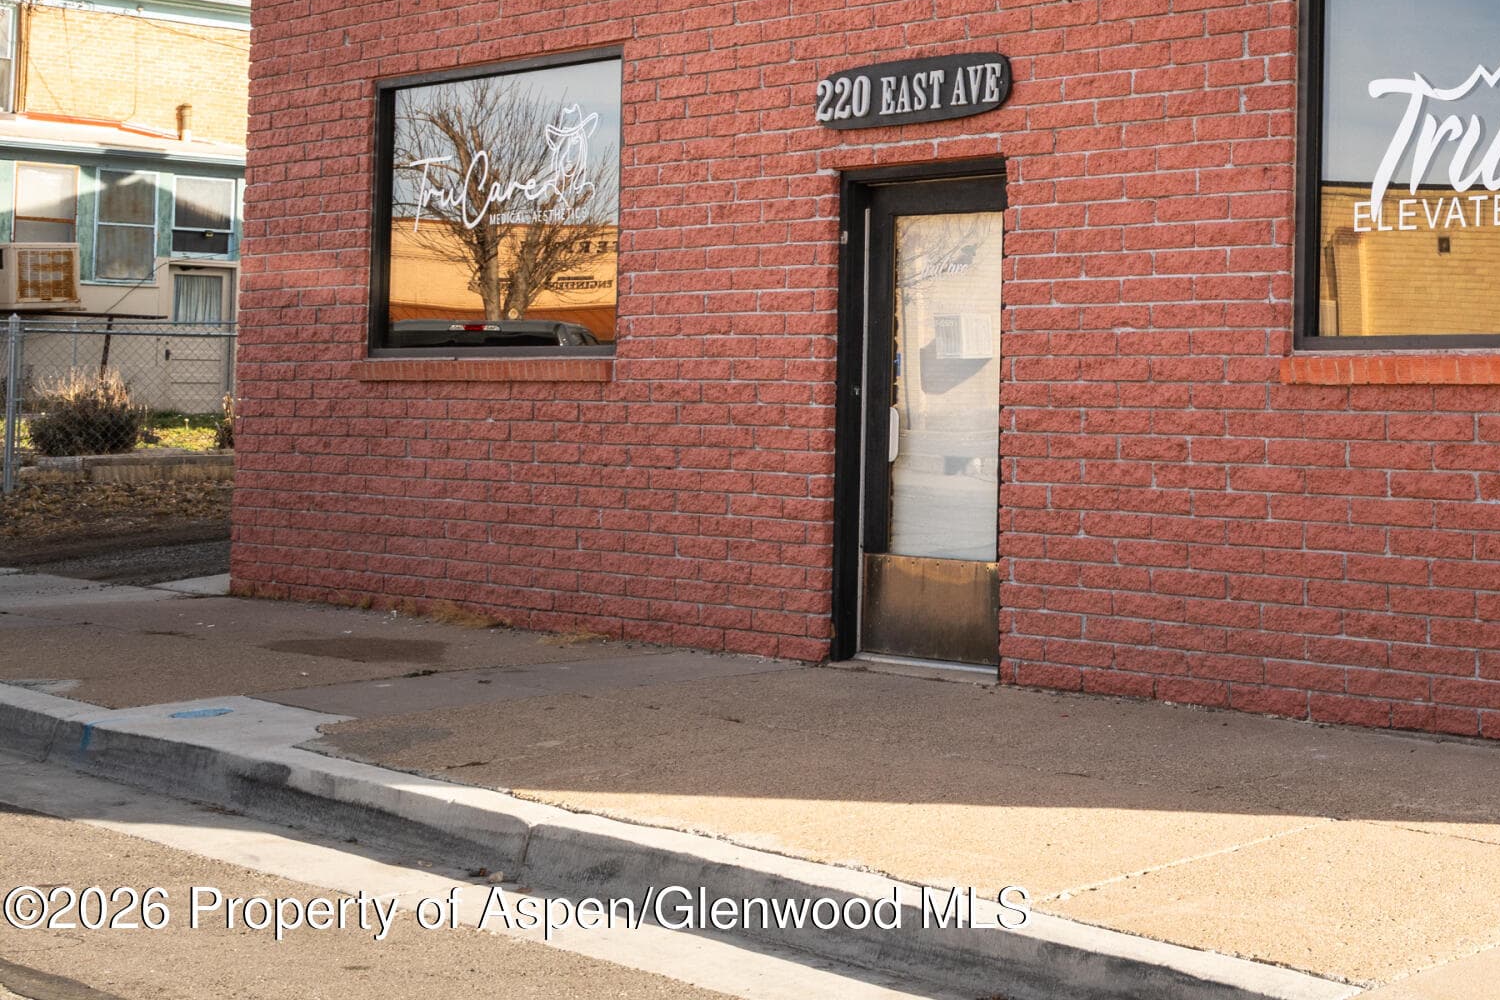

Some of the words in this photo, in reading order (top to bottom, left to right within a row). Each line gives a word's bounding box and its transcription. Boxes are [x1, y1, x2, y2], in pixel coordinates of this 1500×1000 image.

[816, 75, 871, 122] 220
[879, 70, 945, 116] EAST
[950, 62, 1002, 107] AVE
[410, 150, 548, 233] TruCare
[489, 211, 526, 225] MEDICAL
[532, 206, 588, 223] AESTHETICS
